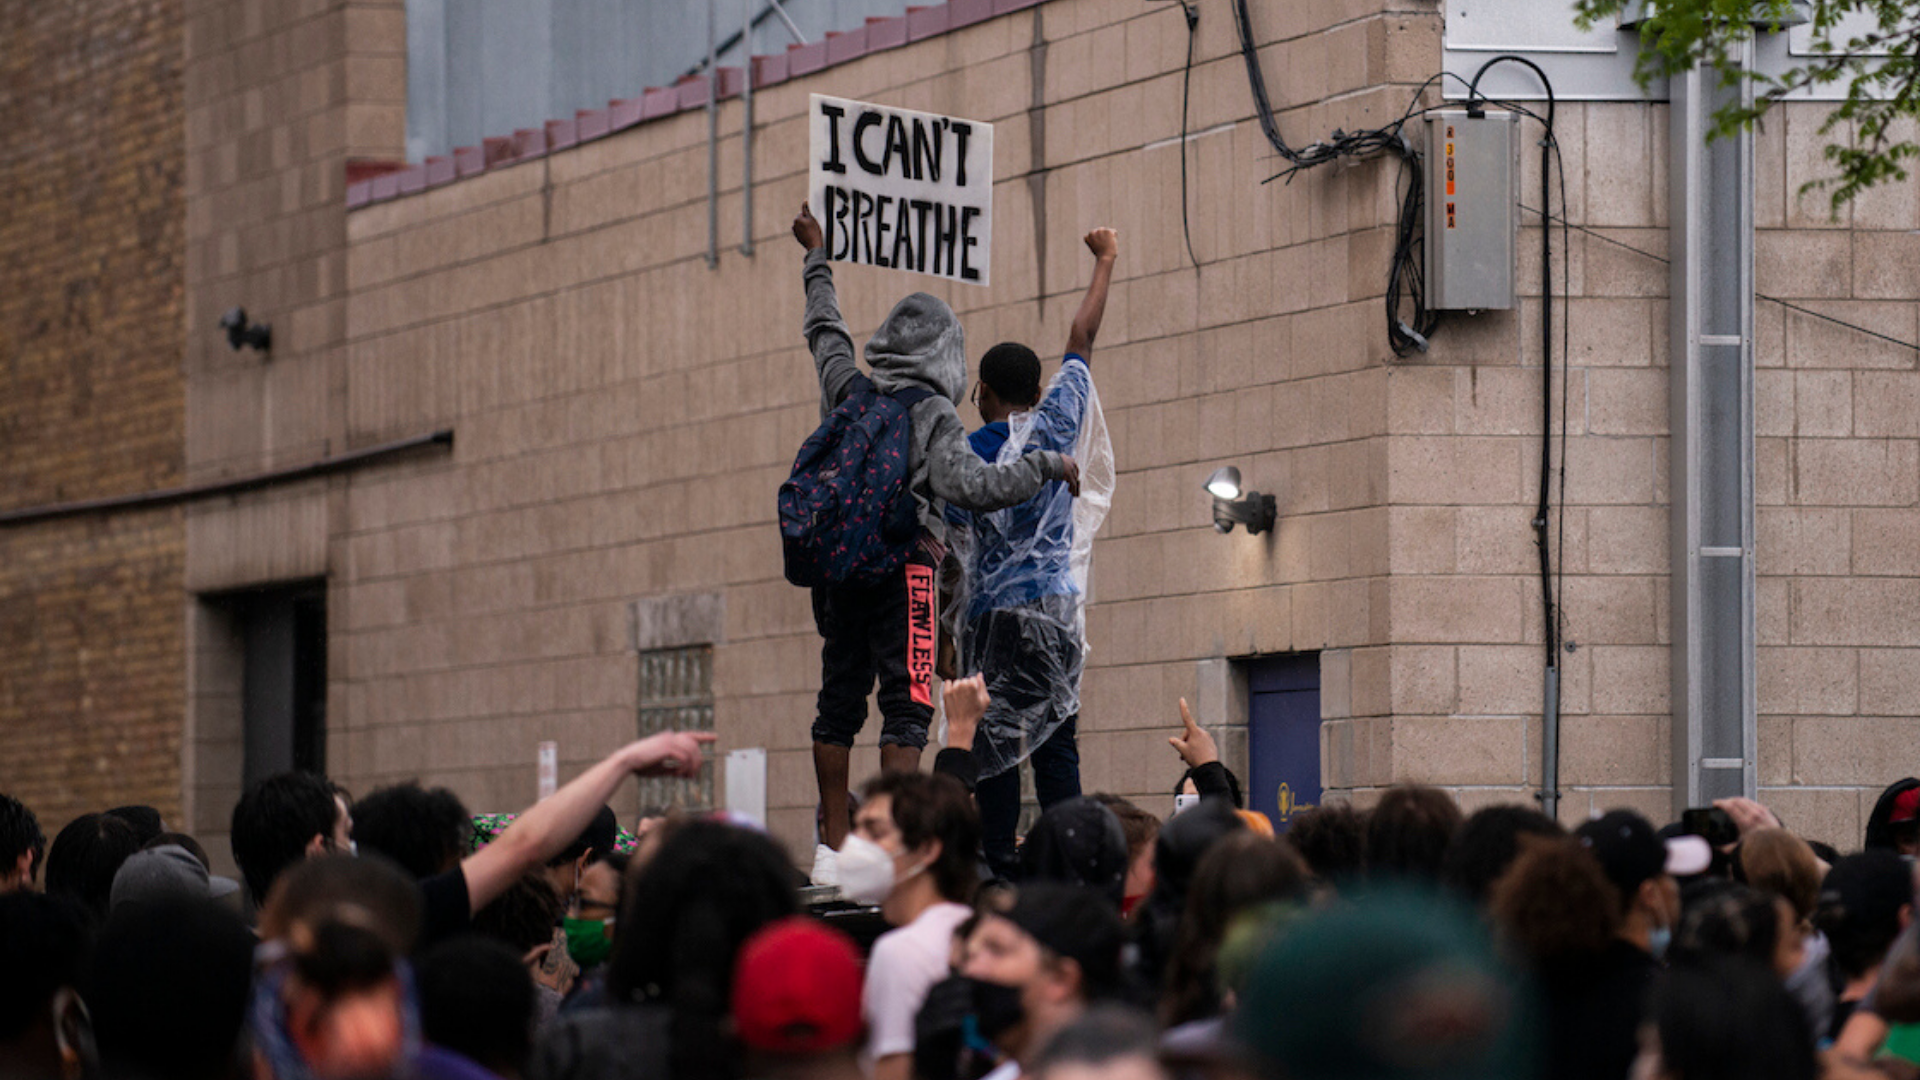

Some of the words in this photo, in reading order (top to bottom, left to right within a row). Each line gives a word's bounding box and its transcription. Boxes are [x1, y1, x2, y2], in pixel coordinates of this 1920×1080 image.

[821, 103, 846, 174] I
[853, 111, 971, 186] CAN'T
[825, 185, 980, 280] BREATHE
[912, 574, 932, 686] FLAWLESS
